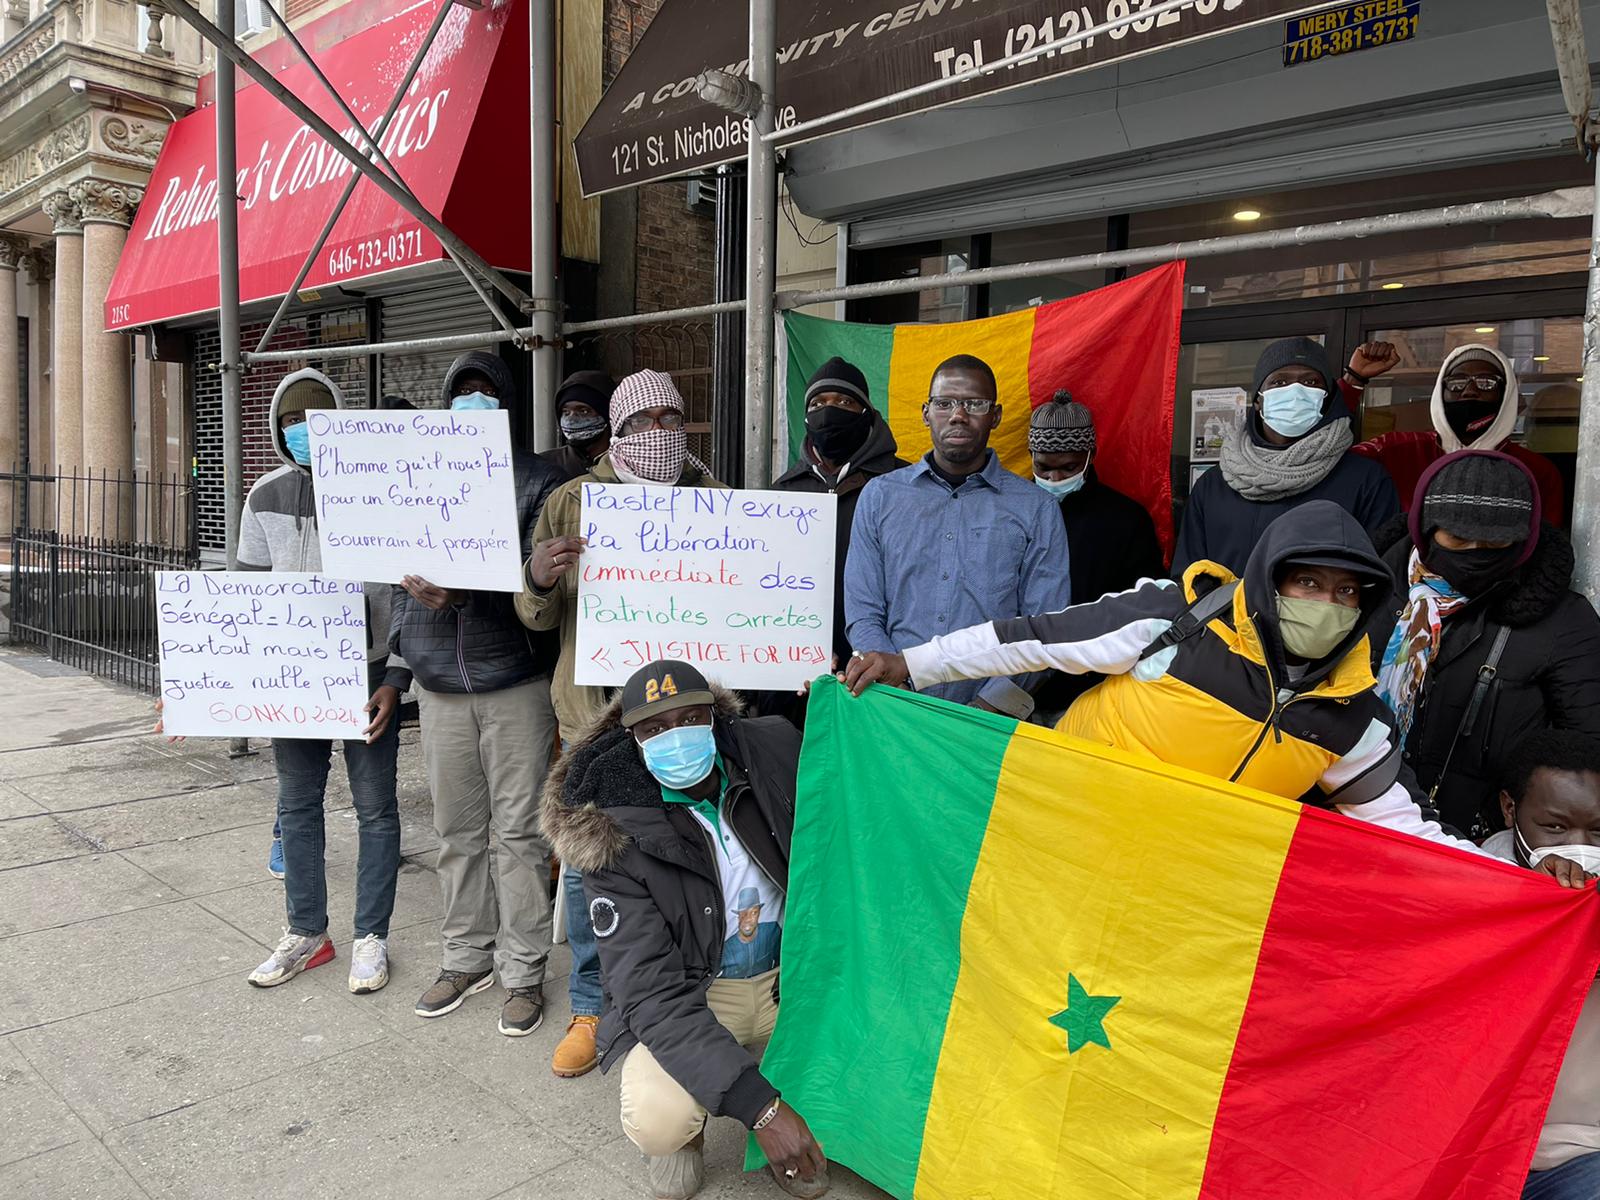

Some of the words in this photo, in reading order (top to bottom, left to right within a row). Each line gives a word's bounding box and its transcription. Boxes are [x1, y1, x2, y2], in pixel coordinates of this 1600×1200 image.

[1298, 9, 1349, 37] MERY
[1353, 0, 1408, 23] STEEL
[1004, 6, 1095, 70] (212)
[1288, 14, 1419, 65] 718-381-3731
[621, 92, 646, 114] A
[611, 140, 640, 176] 121
[646, 135, 670, 168] St.
[329, 227, 423, 277] 646-732-0371
[308, 412, 406, 437] Ousmane
[314, 443, 390, 478] l'homme
[395, 450, 443, 489] qu'il
[447, 458, 482, 472] nous
[481, 447, 511, 478] faut
[320, 492, 357, 519] pour
[362, 494, 384, 506] un
[387, 482, 471, 522] Sénégal
[583, 483, 682, 523] Pastef
[693, 488, 735, 516] NY
[741, 500, 822, 536] exige
[415, 524, 438, 550] et
[583, 522, 622, 551] la
[635, 519, 770, 553] libération
[158, 572, 191, 594] La
[582, 557, 744, 586] immédiate
[758, 560, 816, 591] des
[285, 602, 317, 629] La
[322, 605, 367, 639] police
[580, 593, 709, 627] Patriotes
[262, 641, 329, 660] mais
[338, 638, 367, 662] la
[619, 639, 730, 667] JUSTICE
[739, 643, 782, 665] FOR
[251, 664, 312, 690] nulle
[322, 666, 365, 701] part
[645, 672, 680, 704] 24
[208, 701, 307, 725] SONKO
[311, 704, 360, 727] 2024
